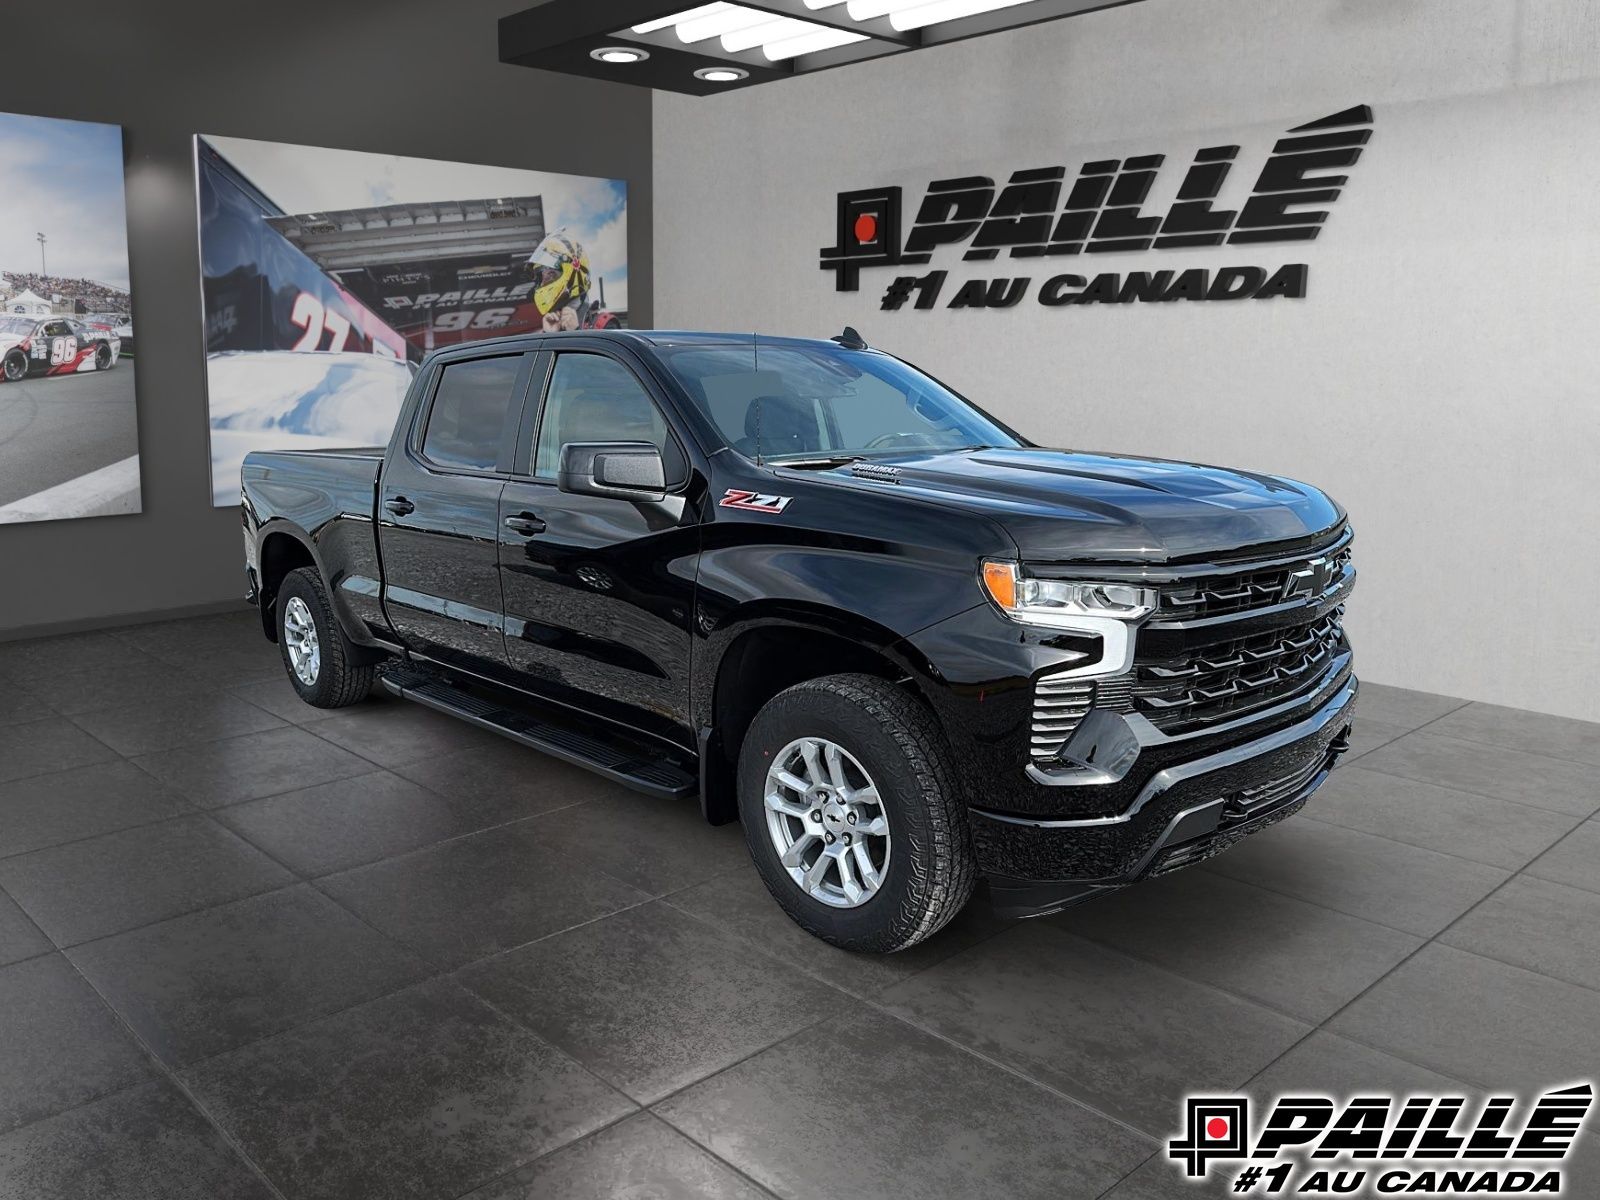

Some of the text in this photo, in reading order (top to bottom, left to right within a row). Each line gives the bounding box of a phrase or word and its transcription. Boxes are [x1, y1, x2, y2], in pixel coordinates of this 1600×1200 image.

[881, 264, 1308, 310] #1 AU CANADA
[432, 307, 516, 333] 96
[51, 336, 78, 366] 96
[719, 488, 794, 514] Z71
